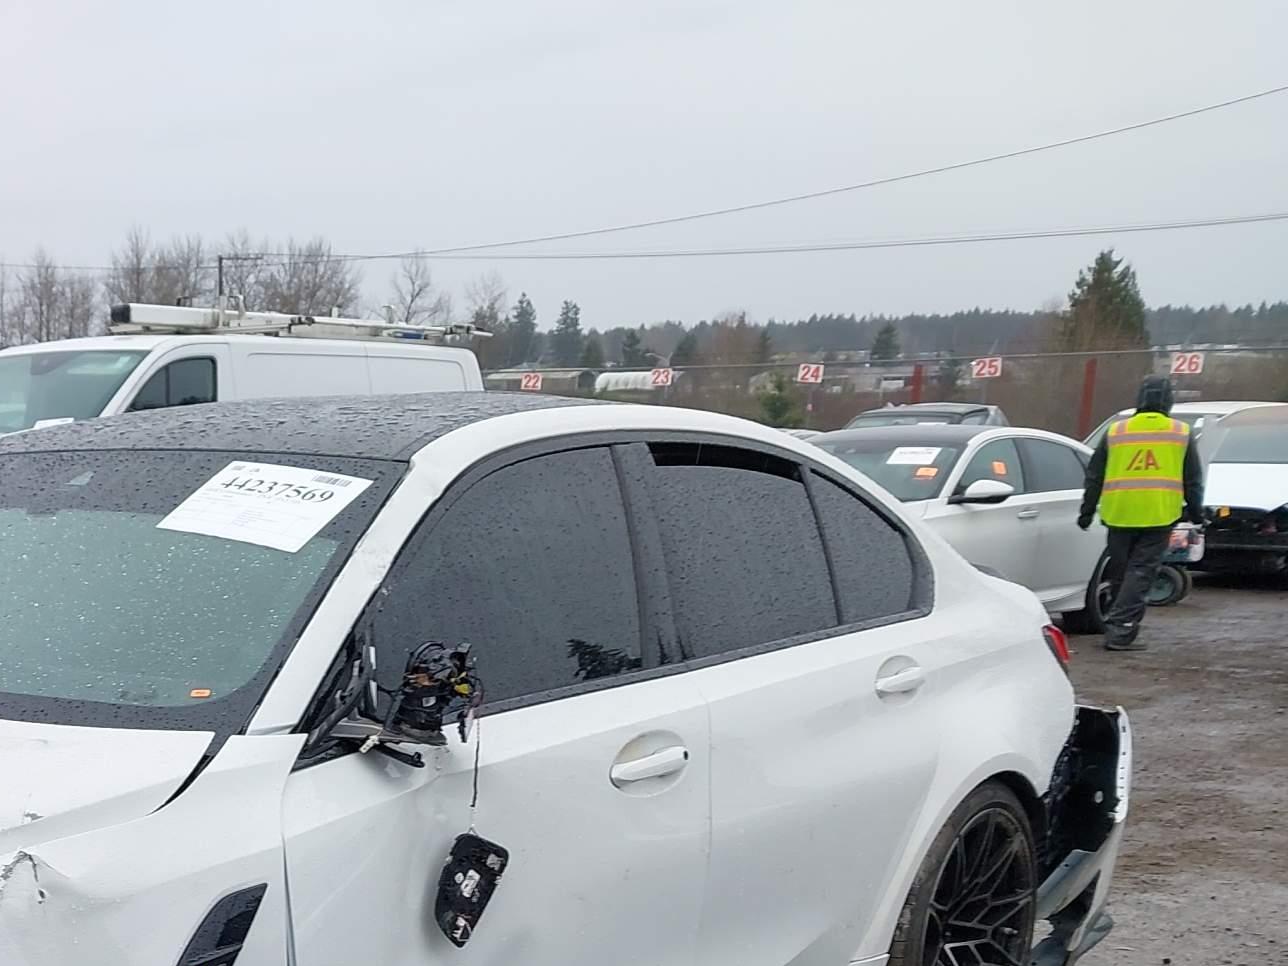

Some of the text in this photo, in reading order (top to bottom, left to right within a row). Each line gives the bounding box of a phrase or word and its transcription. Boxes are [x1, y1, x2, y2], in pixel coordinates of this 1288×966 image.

[975, 359, 999, 376] 25
[1174, 354, 1200, 372] 26
[523, 373, 540, 389] 22
[651, 369, 670, 384] 23
[800, 365, 820, 382] 24
[220, 475, 335, 503] 44237569
